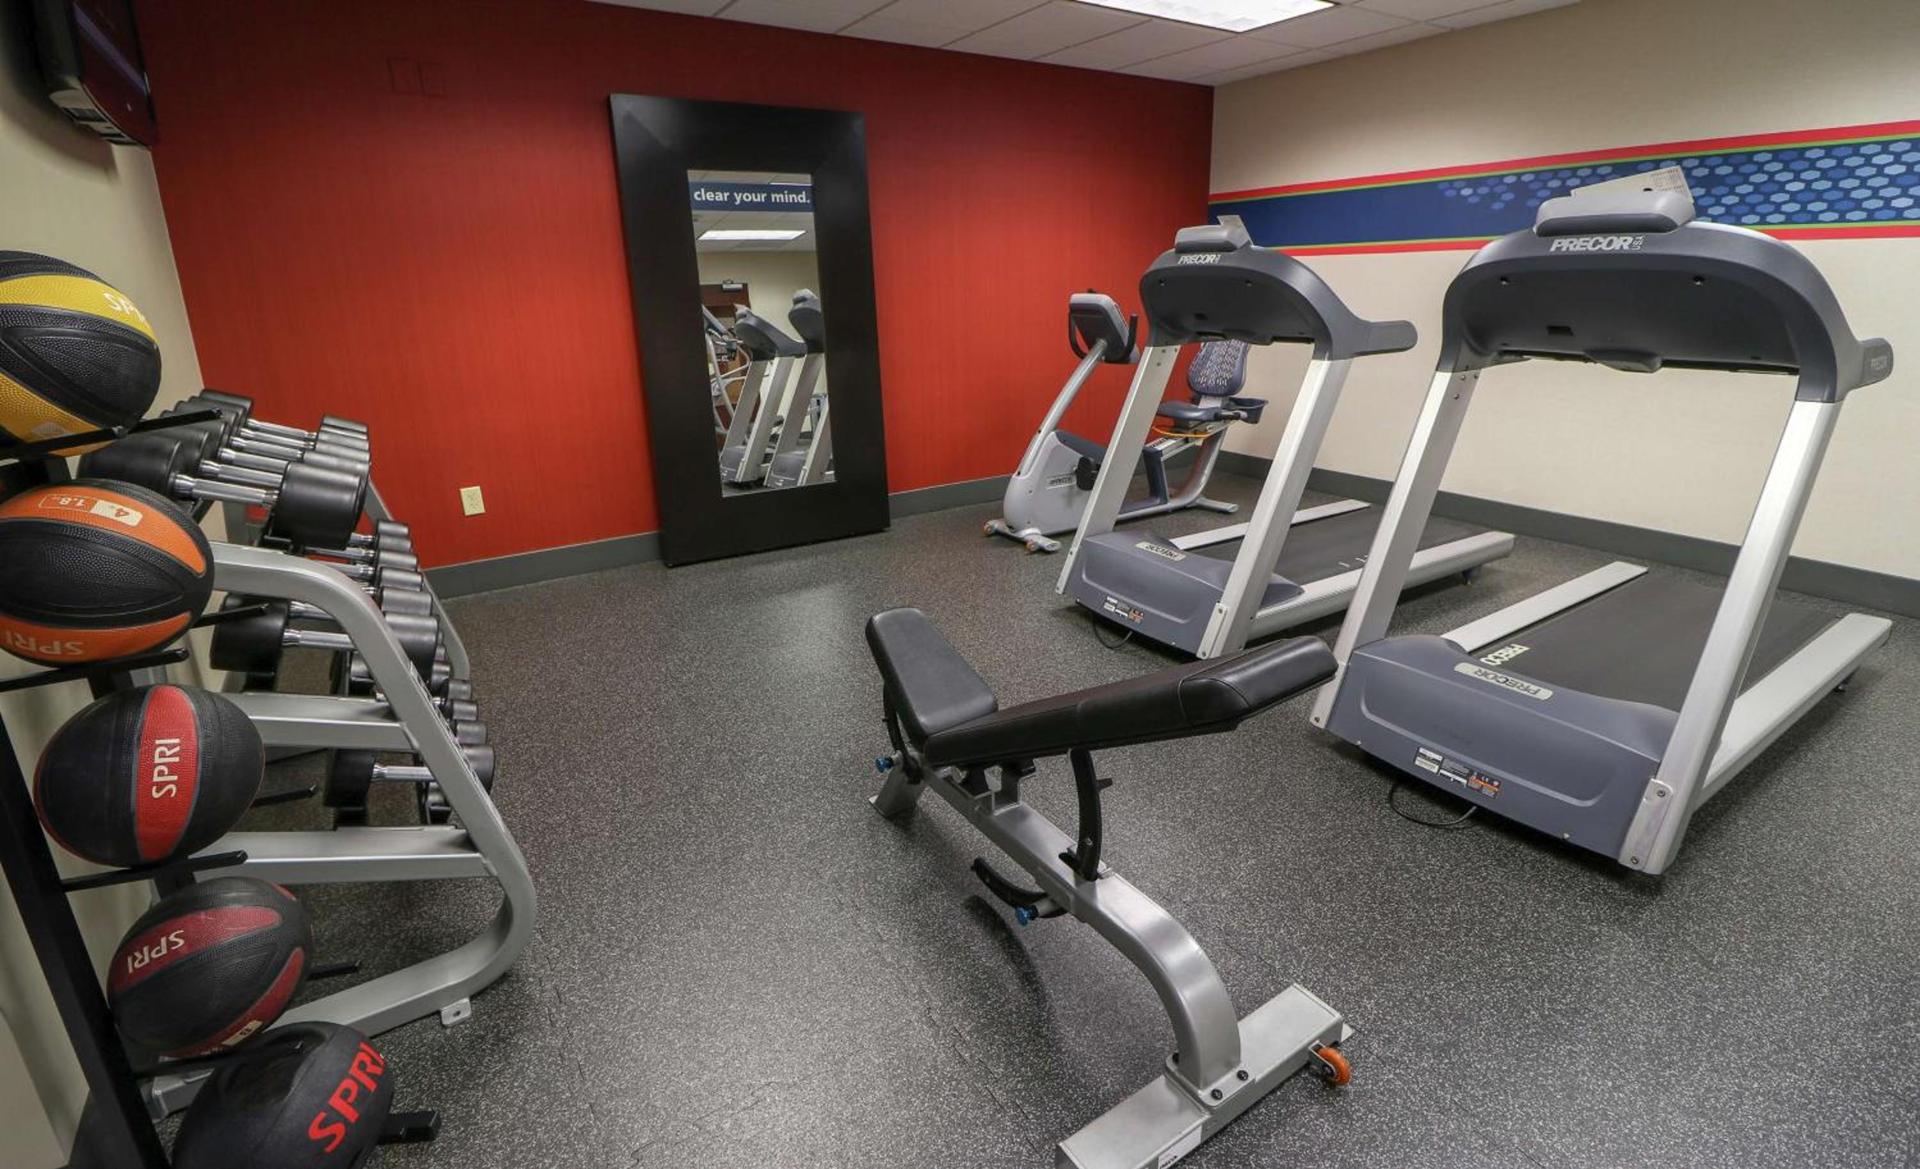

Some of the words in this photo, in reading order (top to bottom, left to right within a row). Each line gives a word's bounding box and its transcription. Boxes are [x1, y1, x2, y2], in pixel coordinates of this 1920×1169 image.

[693, 188, 730, 201] clear
[733, 192, 767, 205] your
[771, 190, 811, 203] mind.
[1549, 236, 1633, 252] PRECOR
[6, 630, 85, 656] SPRI
[1475, 669, 1541, 695] PRECOR
[151, 738, 181, 799] SPRI
[127, 929, 185, 974] SPRI
[308, 1041, 386, 1154] SPRI
